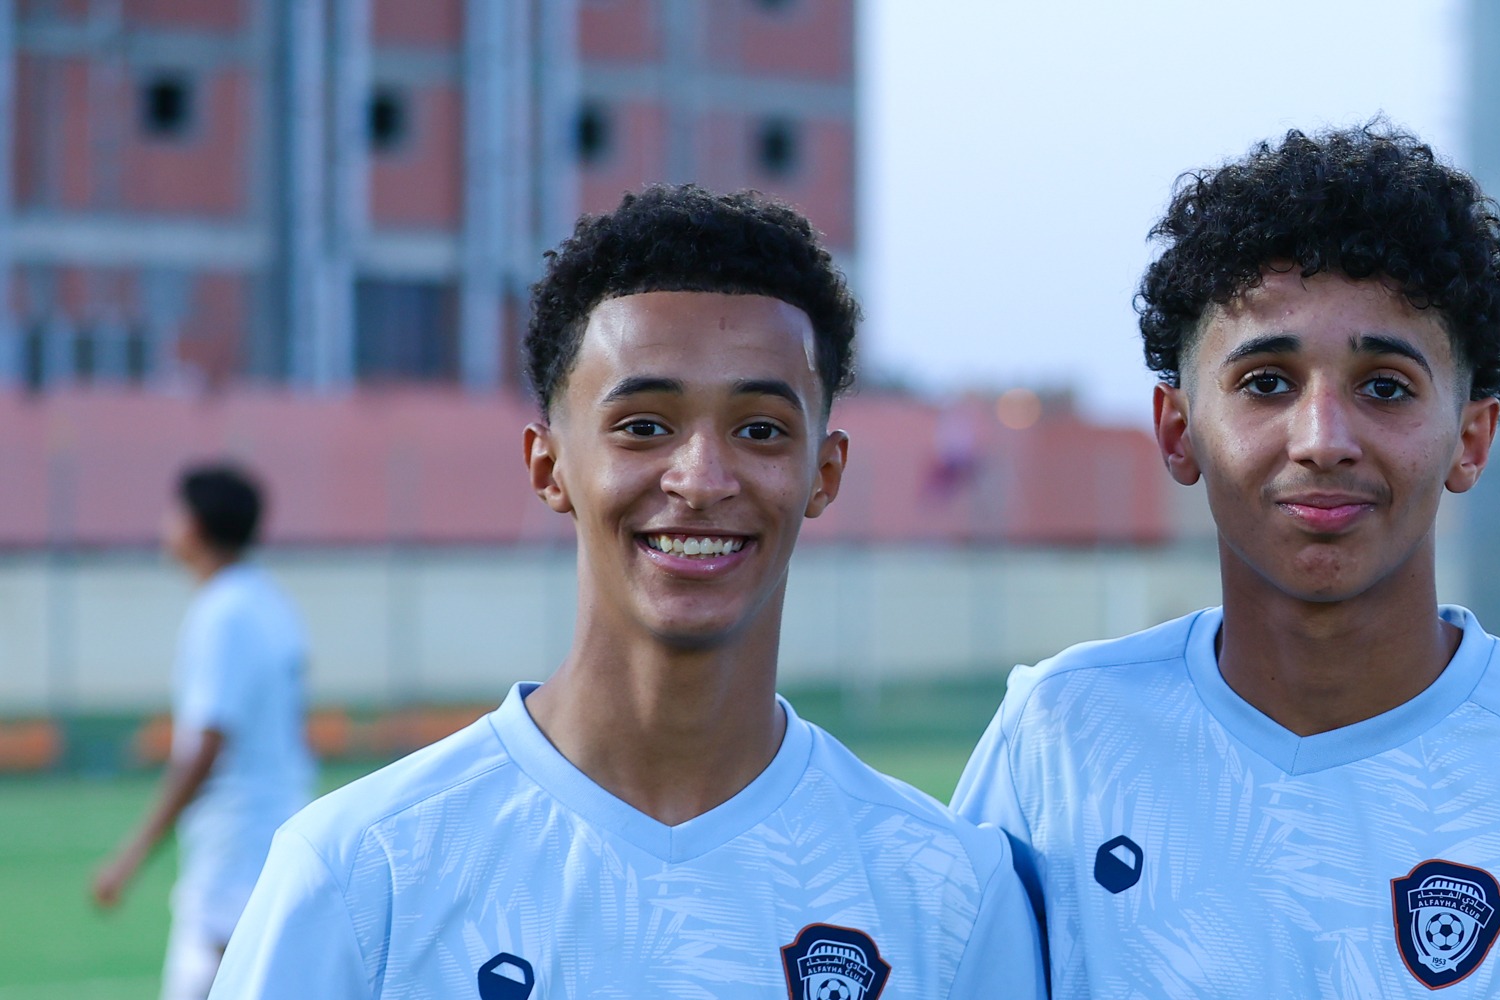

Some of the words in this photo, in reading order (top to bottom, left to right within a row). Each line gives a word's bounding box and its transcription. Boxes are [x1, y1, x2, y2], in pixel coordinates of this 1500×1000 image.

[1418, 899, 1457, 908] ALFAYHA
[1459, 905, 1481, 920] CLUB
[1432, 957, 1447, 965] 1953
[808, 966, 842, 974] ALFAYHA
[844, 970, 864, 984] CLUB
